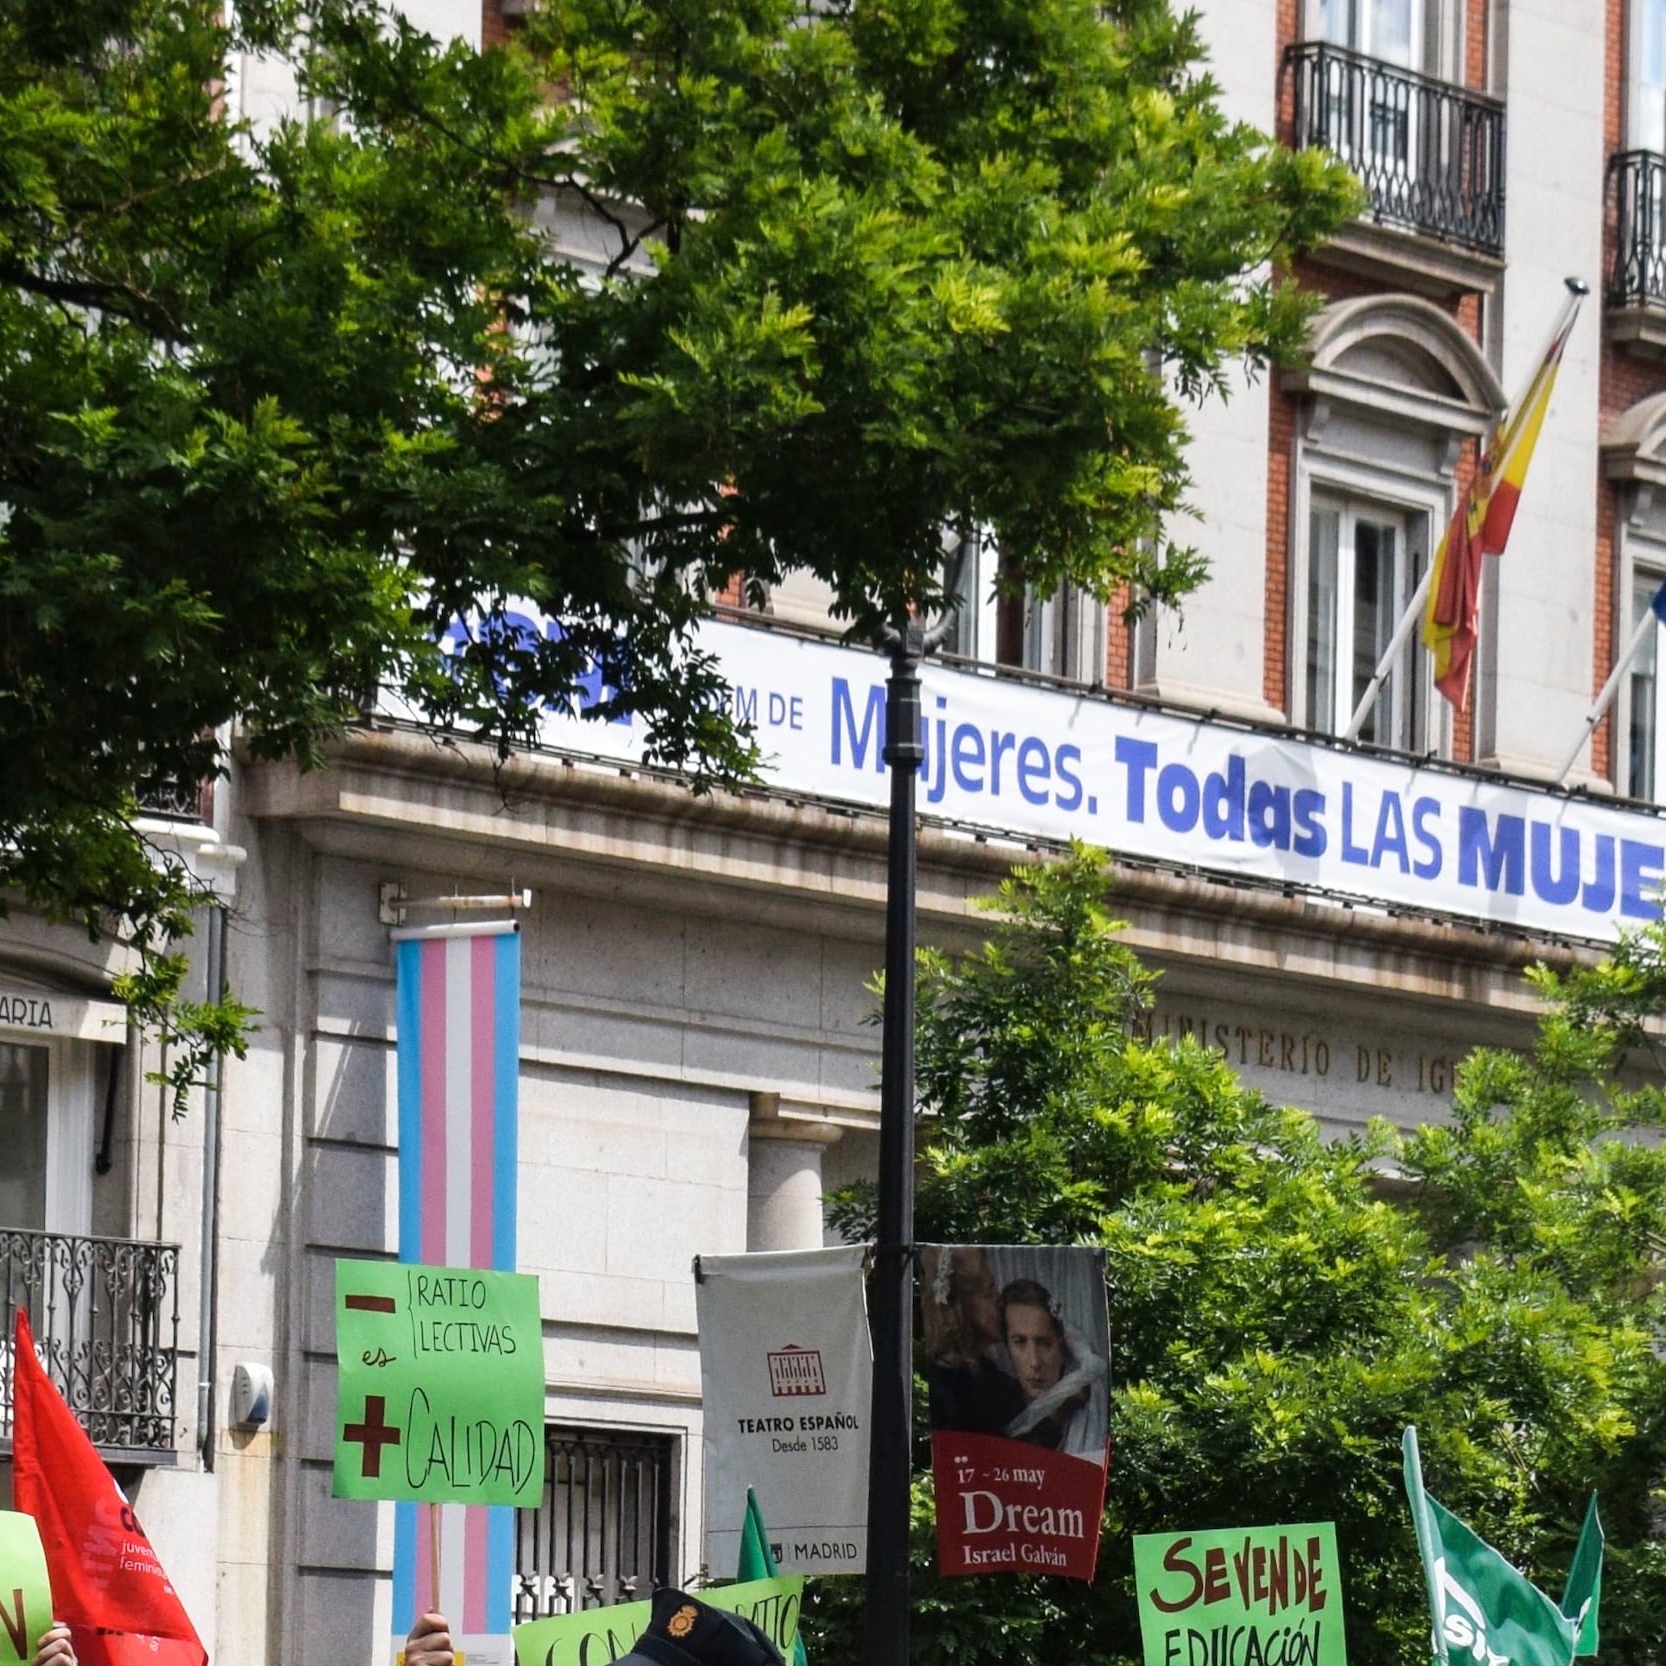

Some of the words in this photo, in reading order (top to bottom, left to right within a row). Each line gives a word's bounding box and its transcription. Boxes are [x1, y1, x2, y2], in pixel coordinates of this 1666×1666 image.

[768, 692, 804, 731] DE
[830, 674, 1099, 816] Mjeres.
[1114, 734, 1327, 860] Todas
[1340, 780, 1444, 882] LAS
[1356, 1043, 1393, 1088] DE
[418, 1274, 487, 1310] RATIO
[420, 1320, 517, 1357] LECTIVAS
[361, 1347, 398, 1368] es
[737, 1414, 795, 1434] TEATRO
[799, 1411, 859, 1431] ESPAÑOL
[406, 1387, 536, 1496] CALIDAD
[771, 1437, 808, 1454] Desde
[811, 1436, 839, 1453] 1583
[993, 1466, 1010, 1483] 26
[1012, 1467, 1046, 1491] may
[959, 1490, 1085, 1540] Dream
[793, 1542, 859, 1561] MADRID
[962, 1543, 1017, 1567] Israel
[1020, 1545, 1068, 1568] Galván
